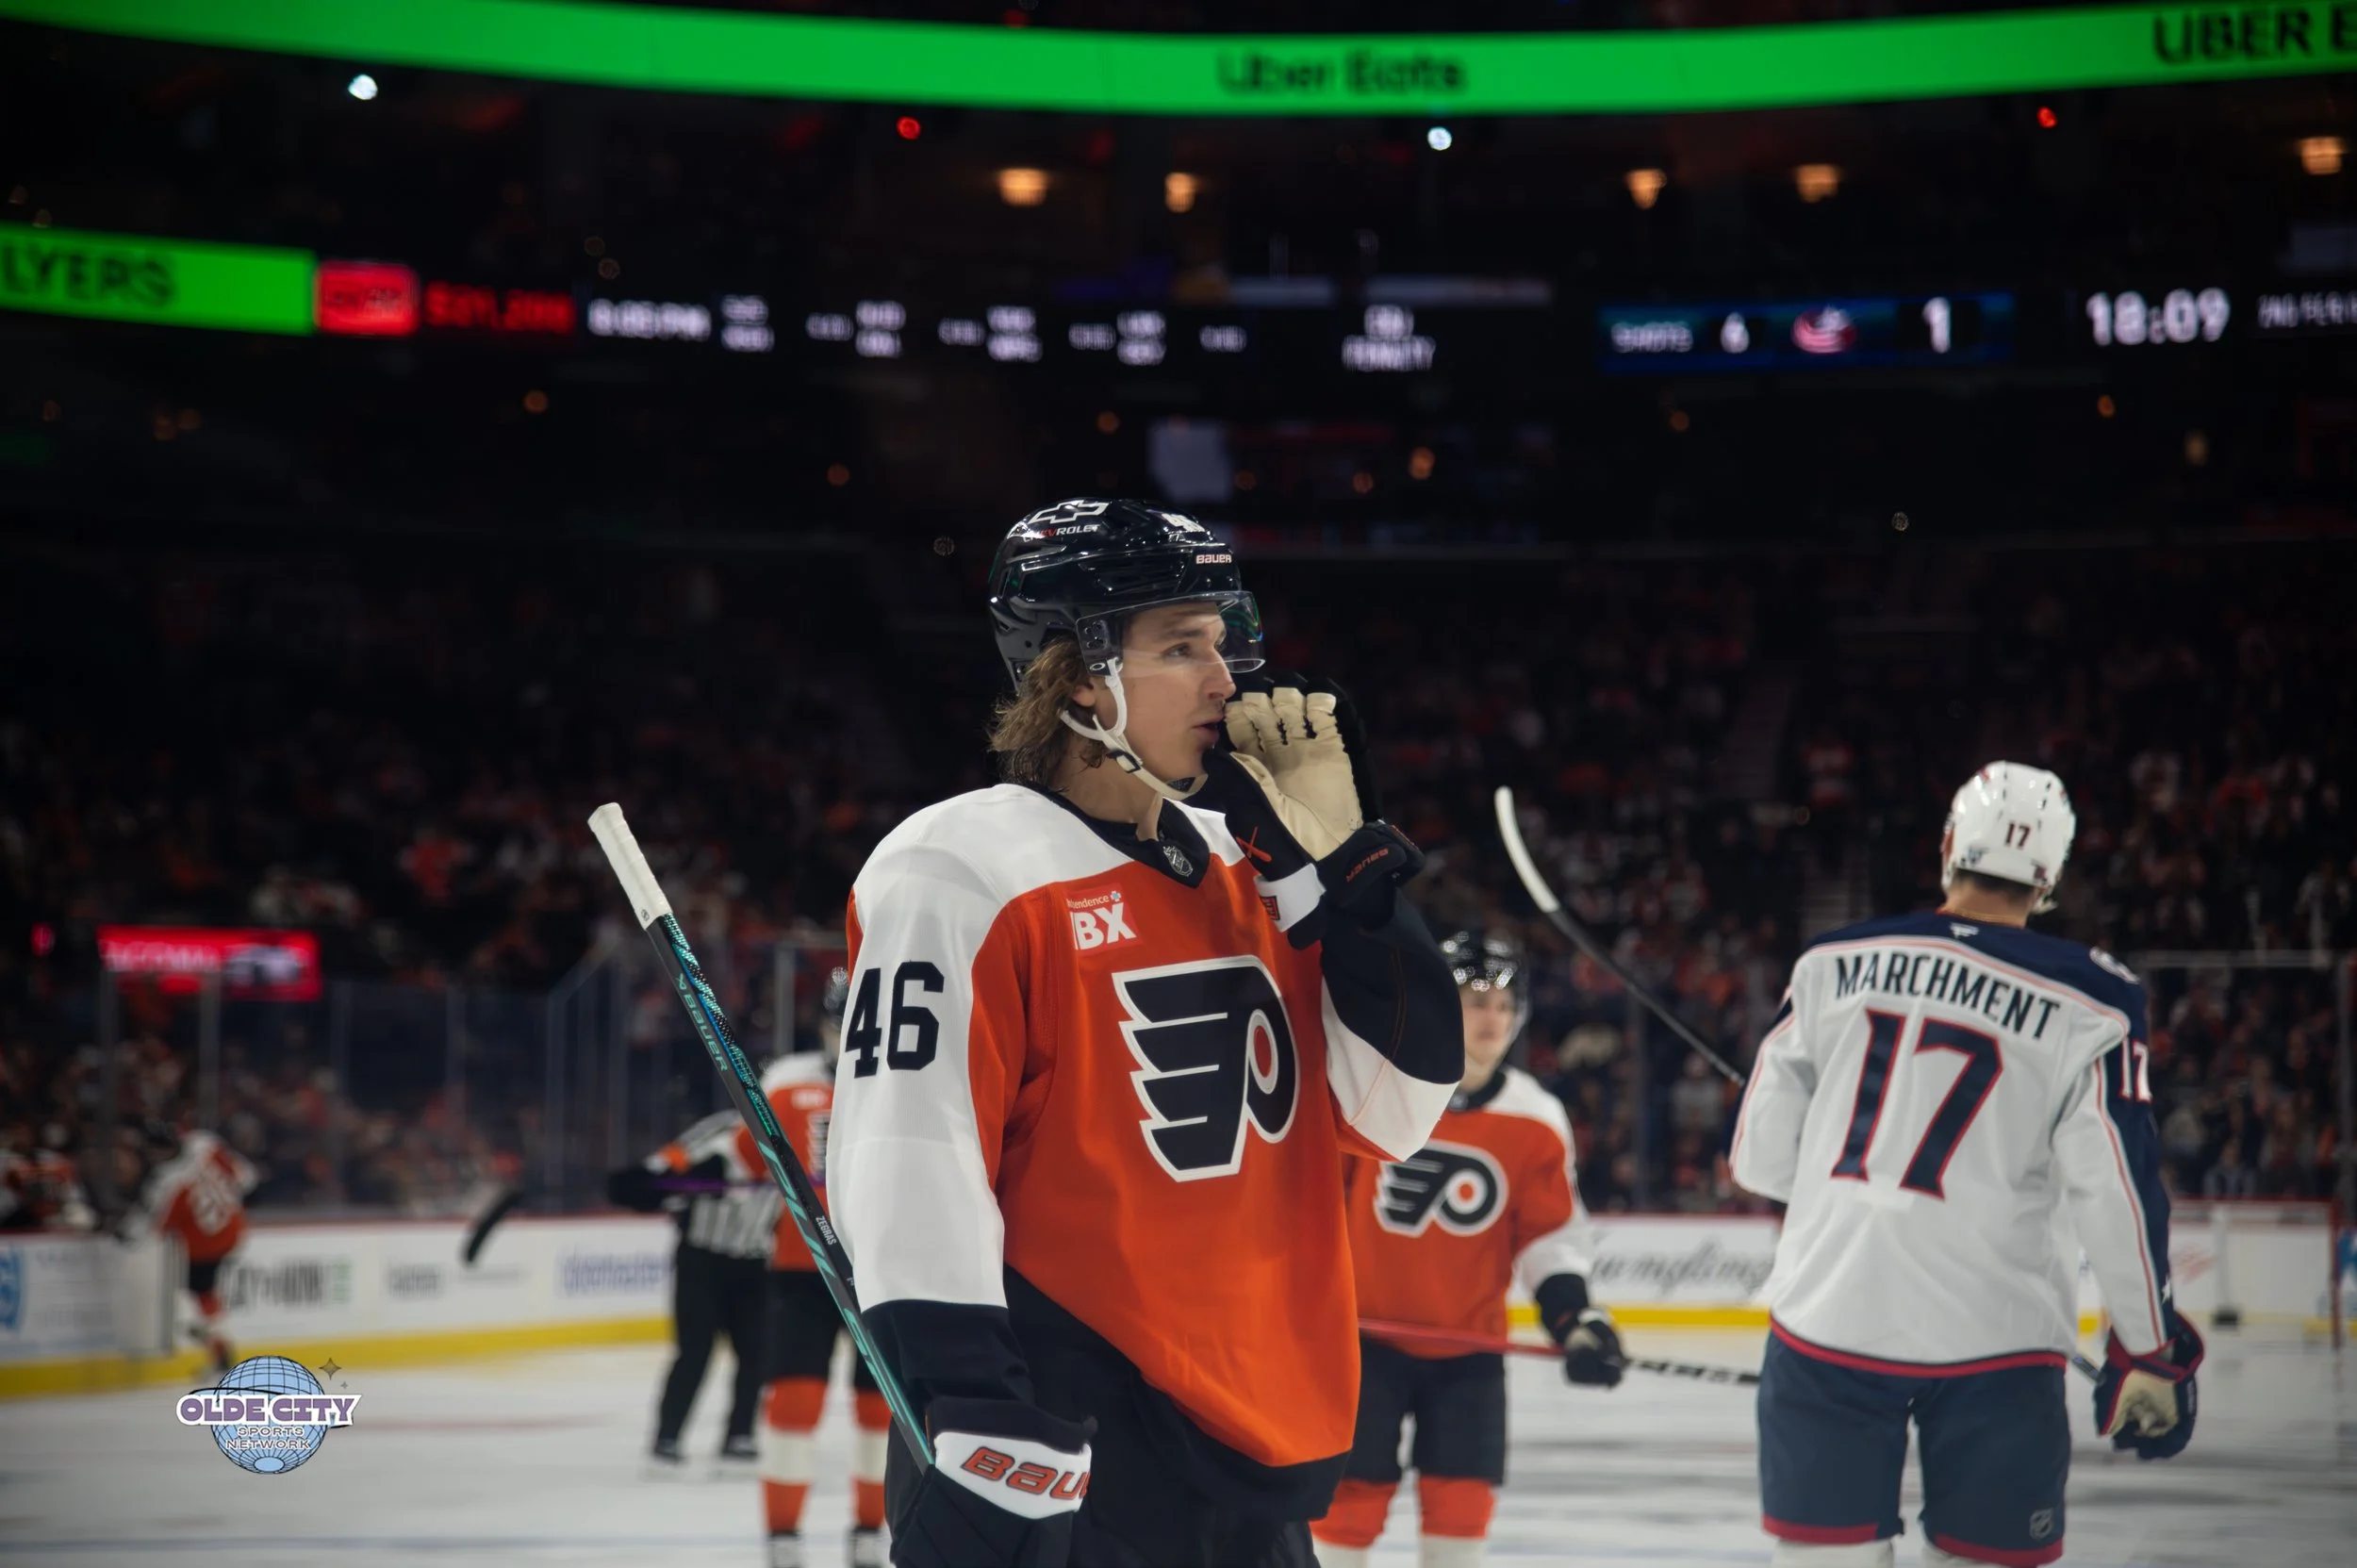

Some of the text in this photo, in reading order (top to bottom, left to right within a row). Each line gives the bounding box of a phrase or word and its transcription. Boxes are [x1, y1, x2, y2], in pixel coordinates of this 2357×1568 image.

[2153, 9, 2314, 65] UBER
[2086, 288, 2231, 346] 18:09
[2003, 820, 2032, 850] 17
[845, 960, 945, 1080] 46
[1835, 950, 2062, 1042] MARCHMENT
[2118, 1035, 2154, 1104] 17
[1828, 1005, 2004, 1204] 17
[815, 1214, 837, 1246] ZEGRAS
[960, 1445, 1091, 1501] BAU
